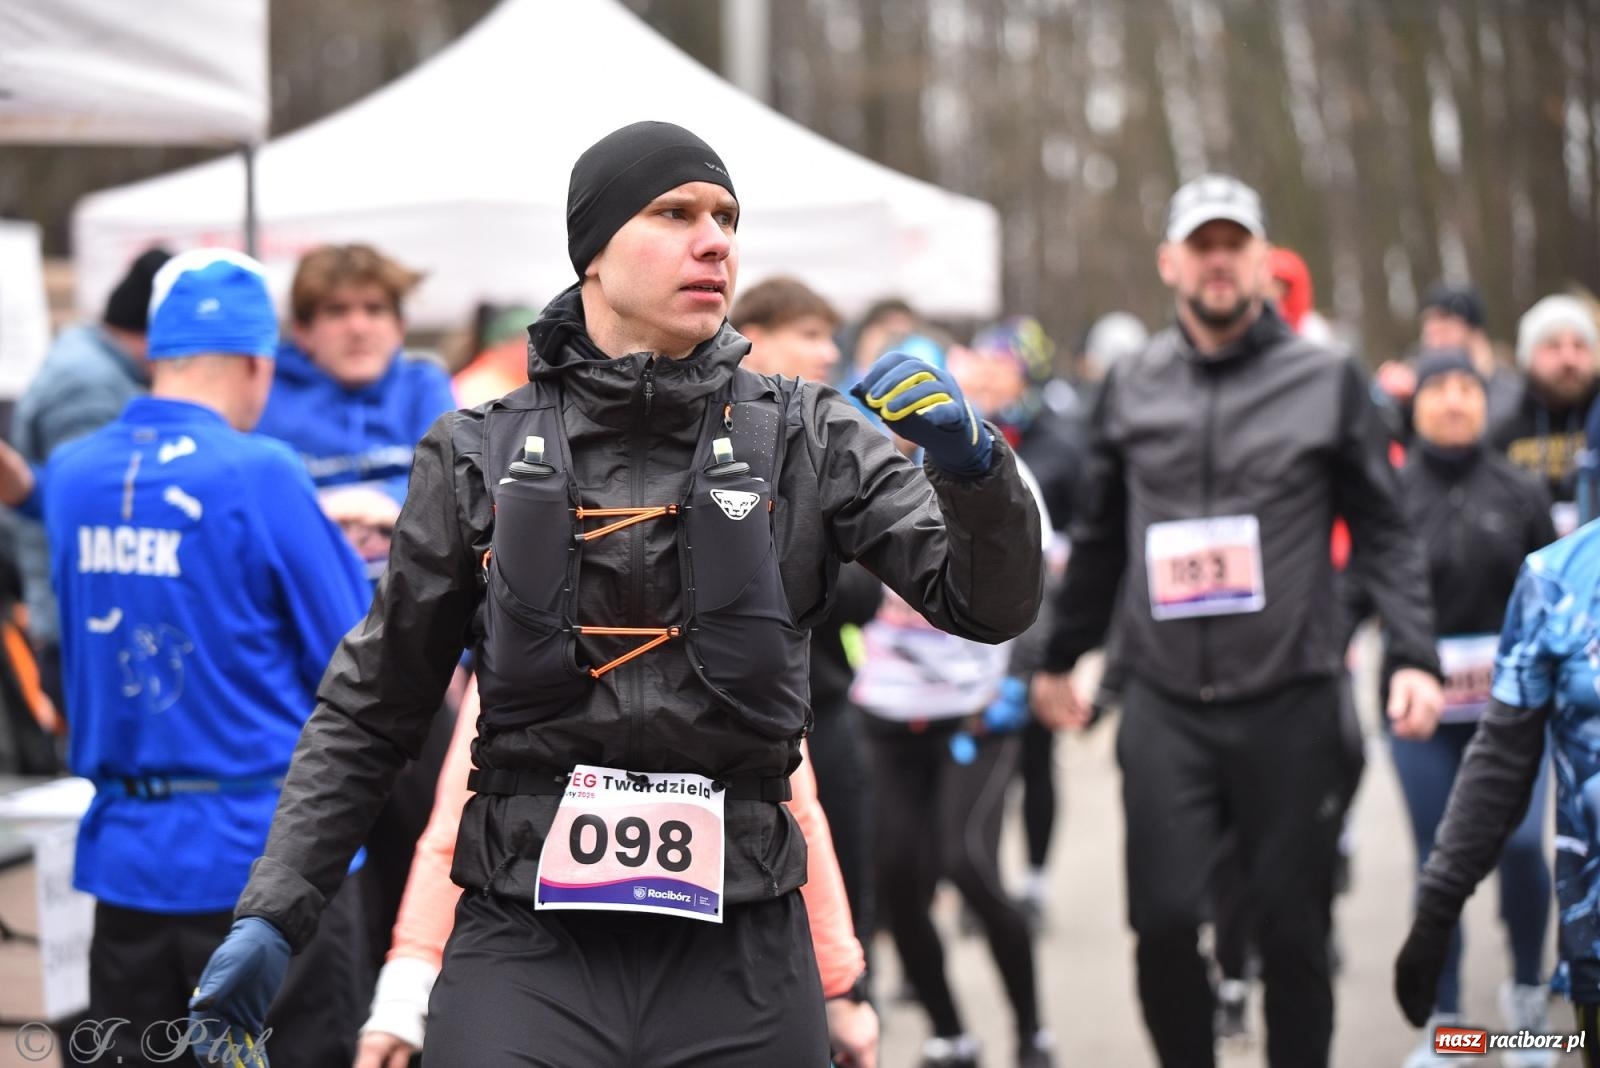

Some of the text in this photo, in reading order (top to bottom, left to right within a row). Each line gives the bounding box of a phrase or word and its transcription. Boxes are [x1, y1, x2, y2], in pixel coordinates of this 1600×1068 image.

[78, 525, 182, 577] JACEK
[569, 814, 693, 872] 098
[647, 888, 691, 903] Racibórz
